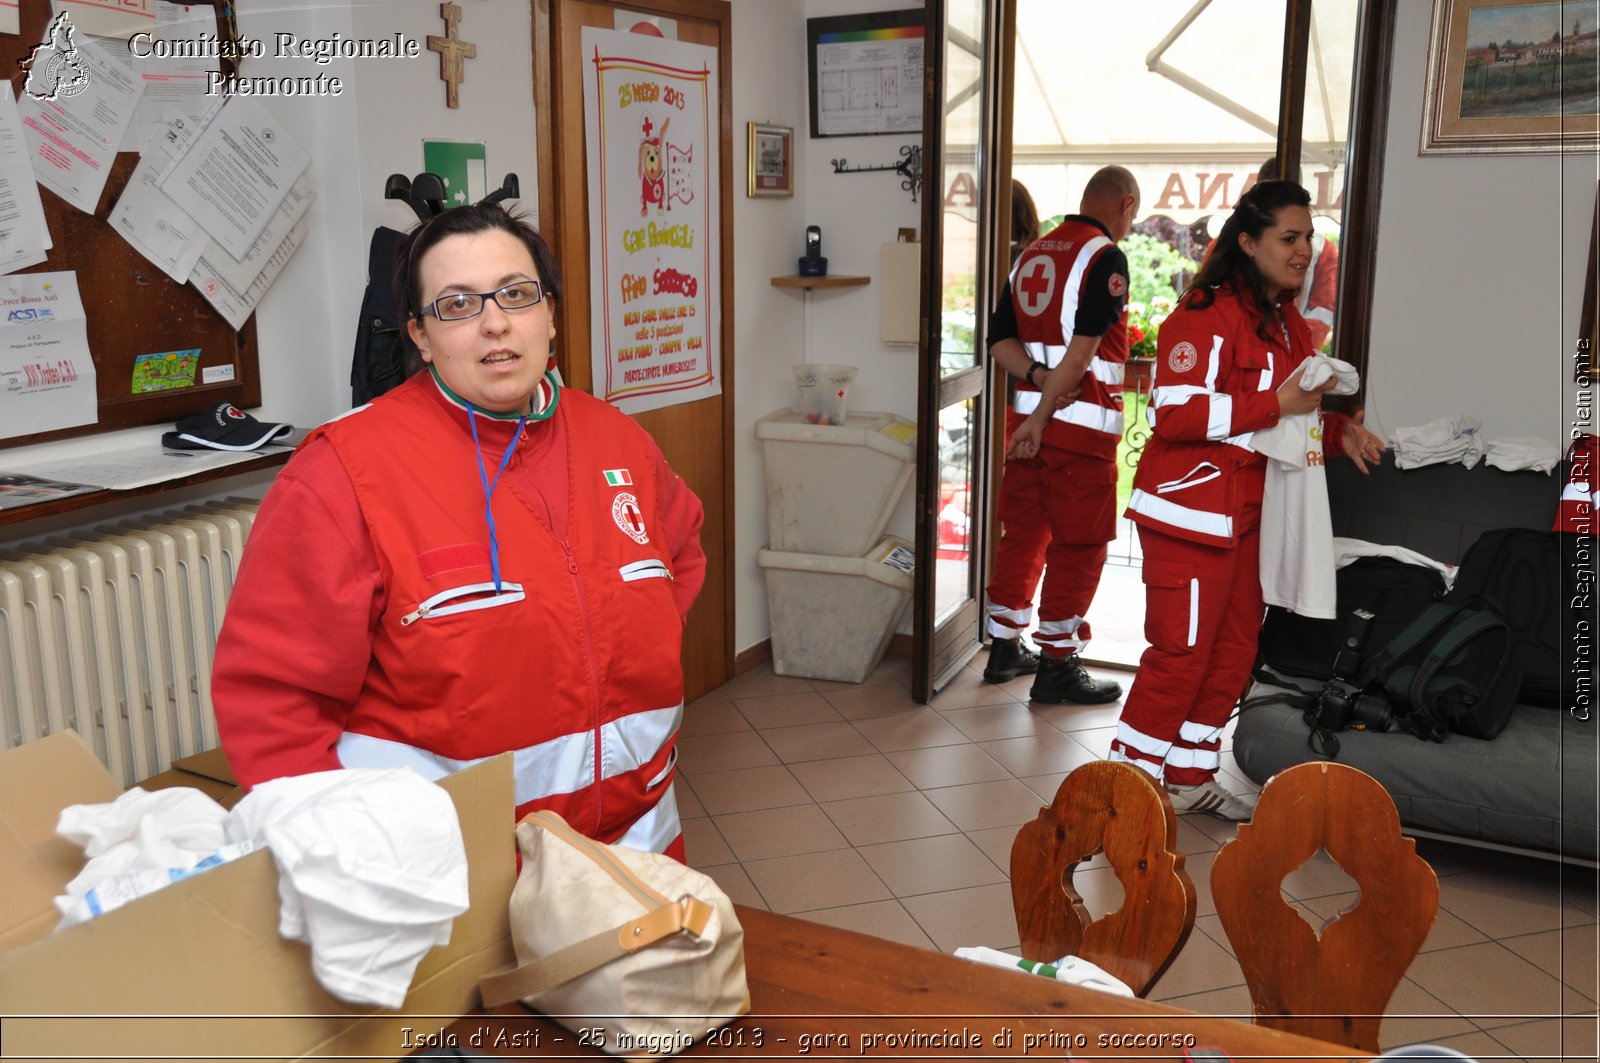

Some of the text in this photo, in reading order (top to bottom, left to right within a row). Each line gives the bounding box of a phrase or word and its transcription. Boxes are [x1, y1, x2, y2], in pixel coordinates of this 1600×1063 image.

[618, 83, 632, 108] 25
[664, 85, 685, 110] 2013
[624, 365, 661, 384] PARTECIPATE
